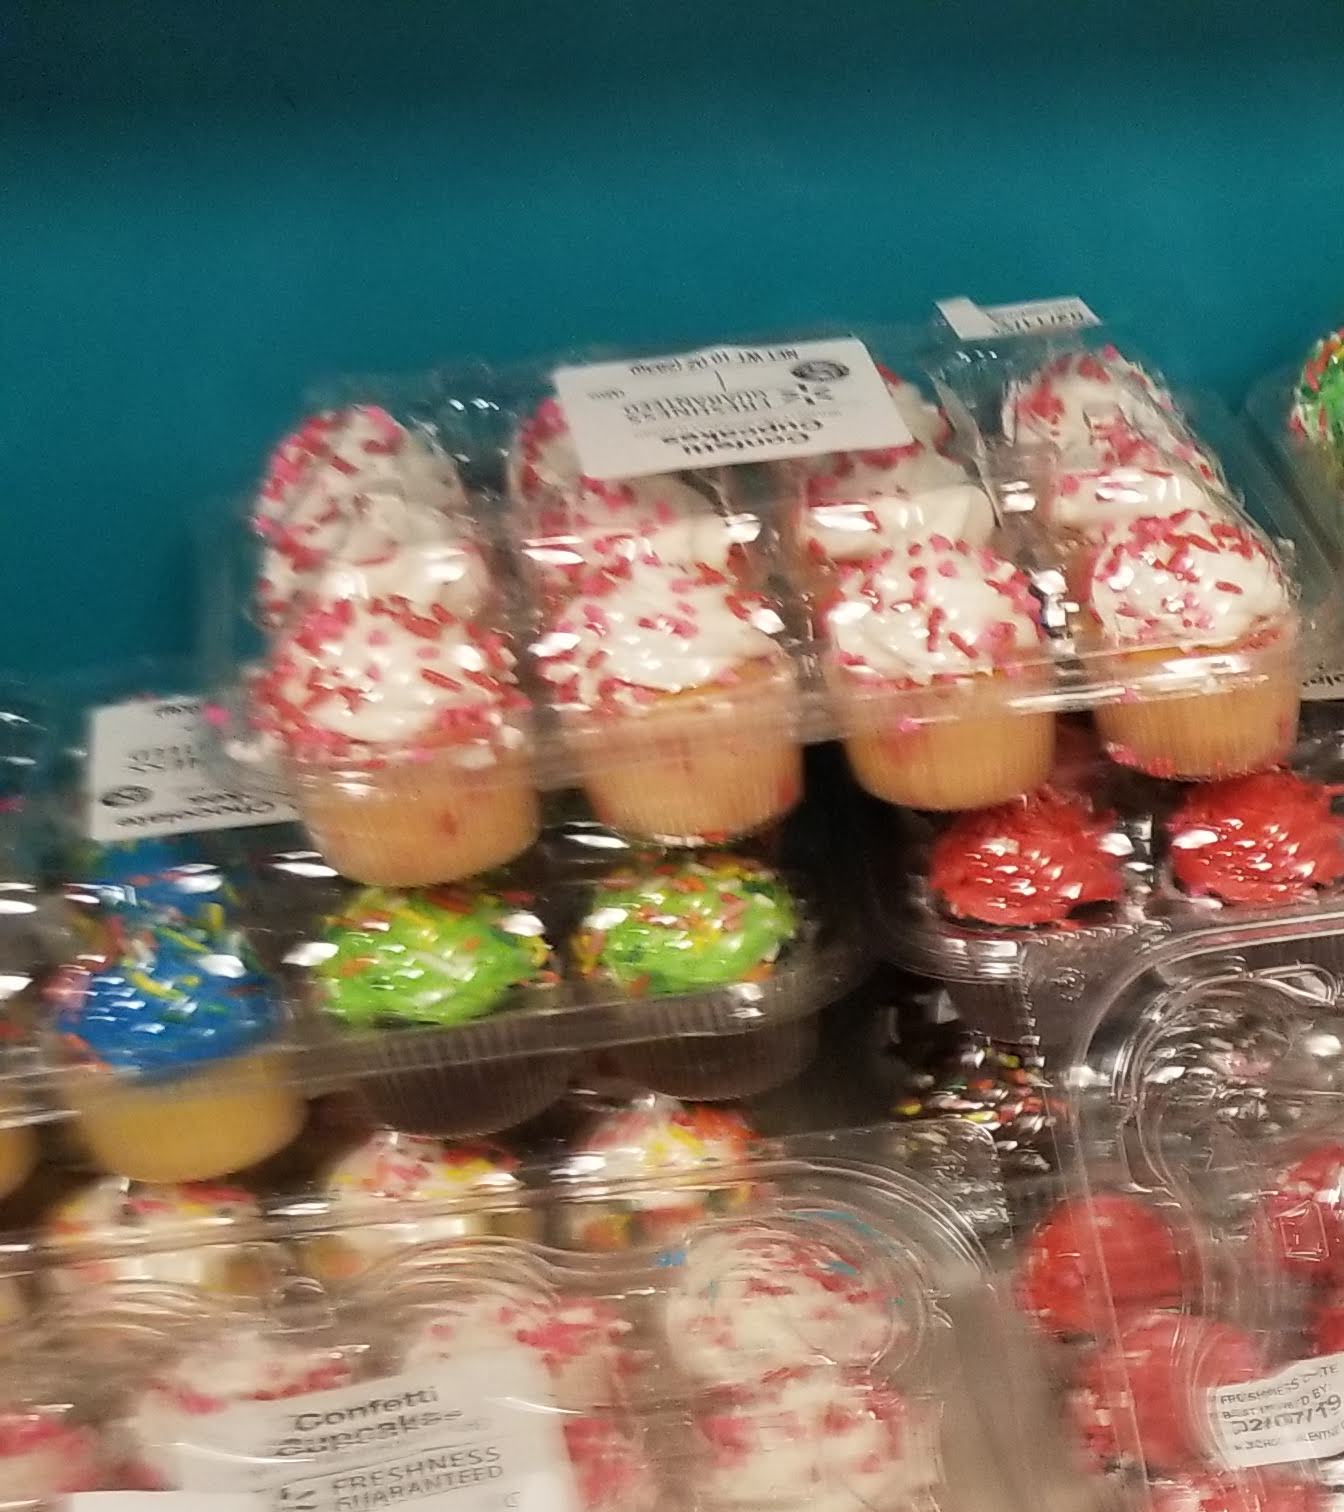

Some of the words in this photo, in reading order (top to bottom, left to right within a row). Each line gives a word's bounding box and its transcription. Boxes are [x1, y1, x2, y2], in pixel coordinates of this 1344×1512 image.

[294, 1385, 439, 1432] Confetti
[332, 1446, 501, 1490] FRESHNESS
[336, 1464, 504, 1512] GUARANTEED
